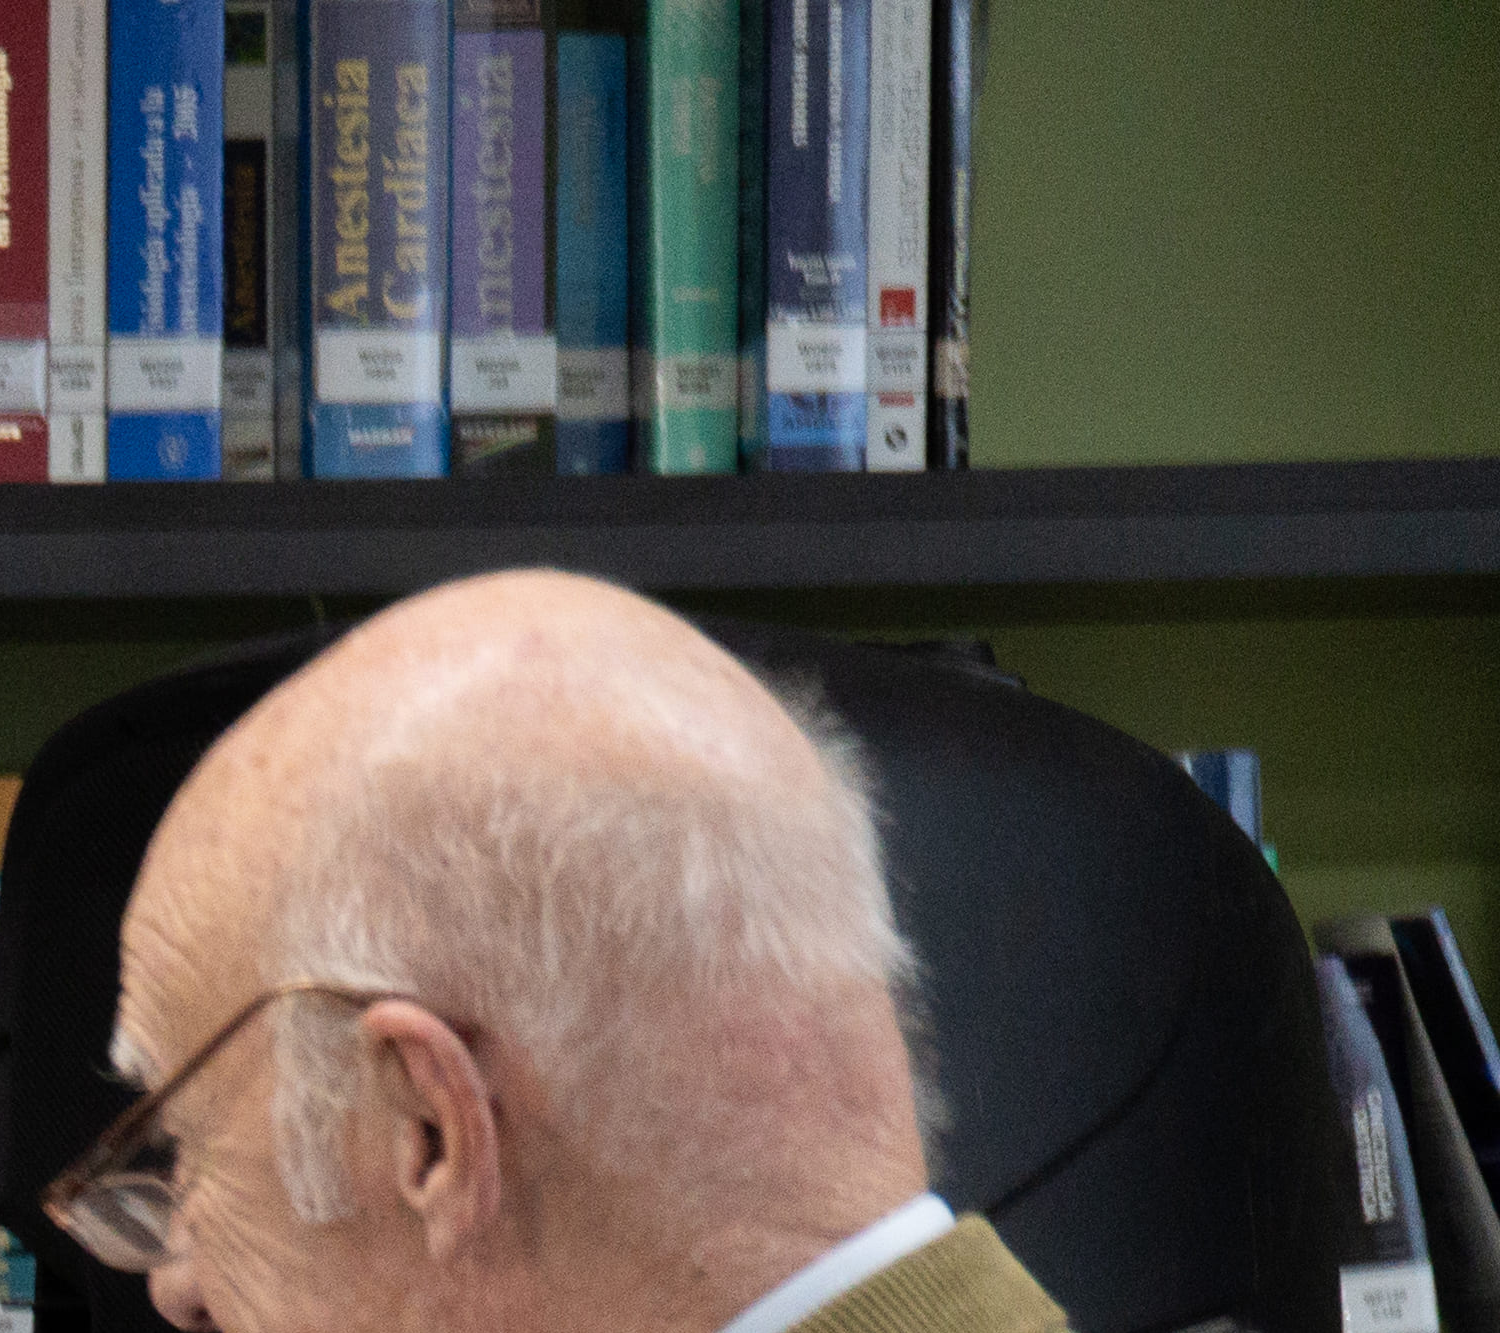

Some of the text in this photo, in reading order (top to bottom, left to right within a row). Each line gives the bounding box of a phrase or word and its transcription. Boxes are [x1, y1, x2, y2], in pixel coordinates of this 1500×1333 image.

[137, 236, 172, 333] isiología
[171, 184, 204, 334] nestesiología
[325, 57, 372, 319] Anestesia
[381, 63, 432, 320] Cardíaca
[461, 54, 514, 322] nestesia
